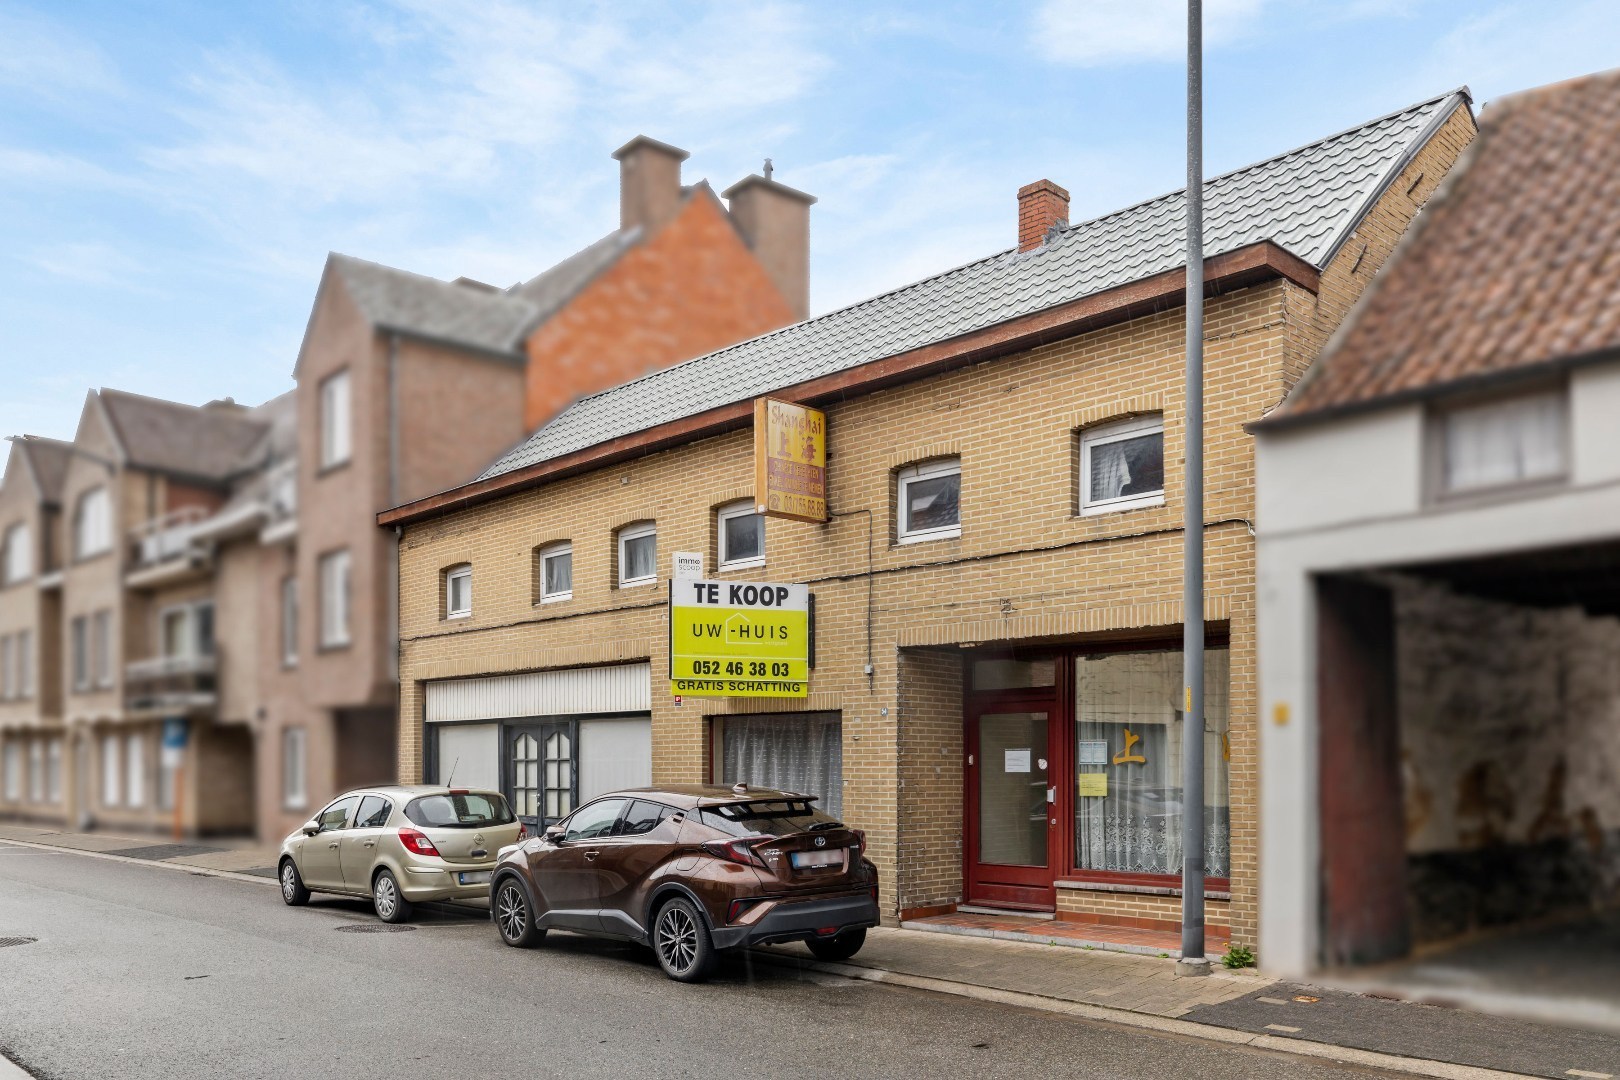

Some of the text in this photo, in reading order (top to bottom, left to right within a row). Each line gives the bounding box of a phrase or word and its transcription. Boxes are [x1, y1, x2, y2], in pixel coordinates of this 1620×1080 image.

[771, 405, 821, 436] Shanghai
[678, 556, 700, 565] immo
[693, 583, 789, 606] TE KOOP
[693, 660, 789, 677] 052 46 38 03
[677, 681, 801, 693] GRATIS SCHATTING
[1112, 728, 1146, 765] 上
